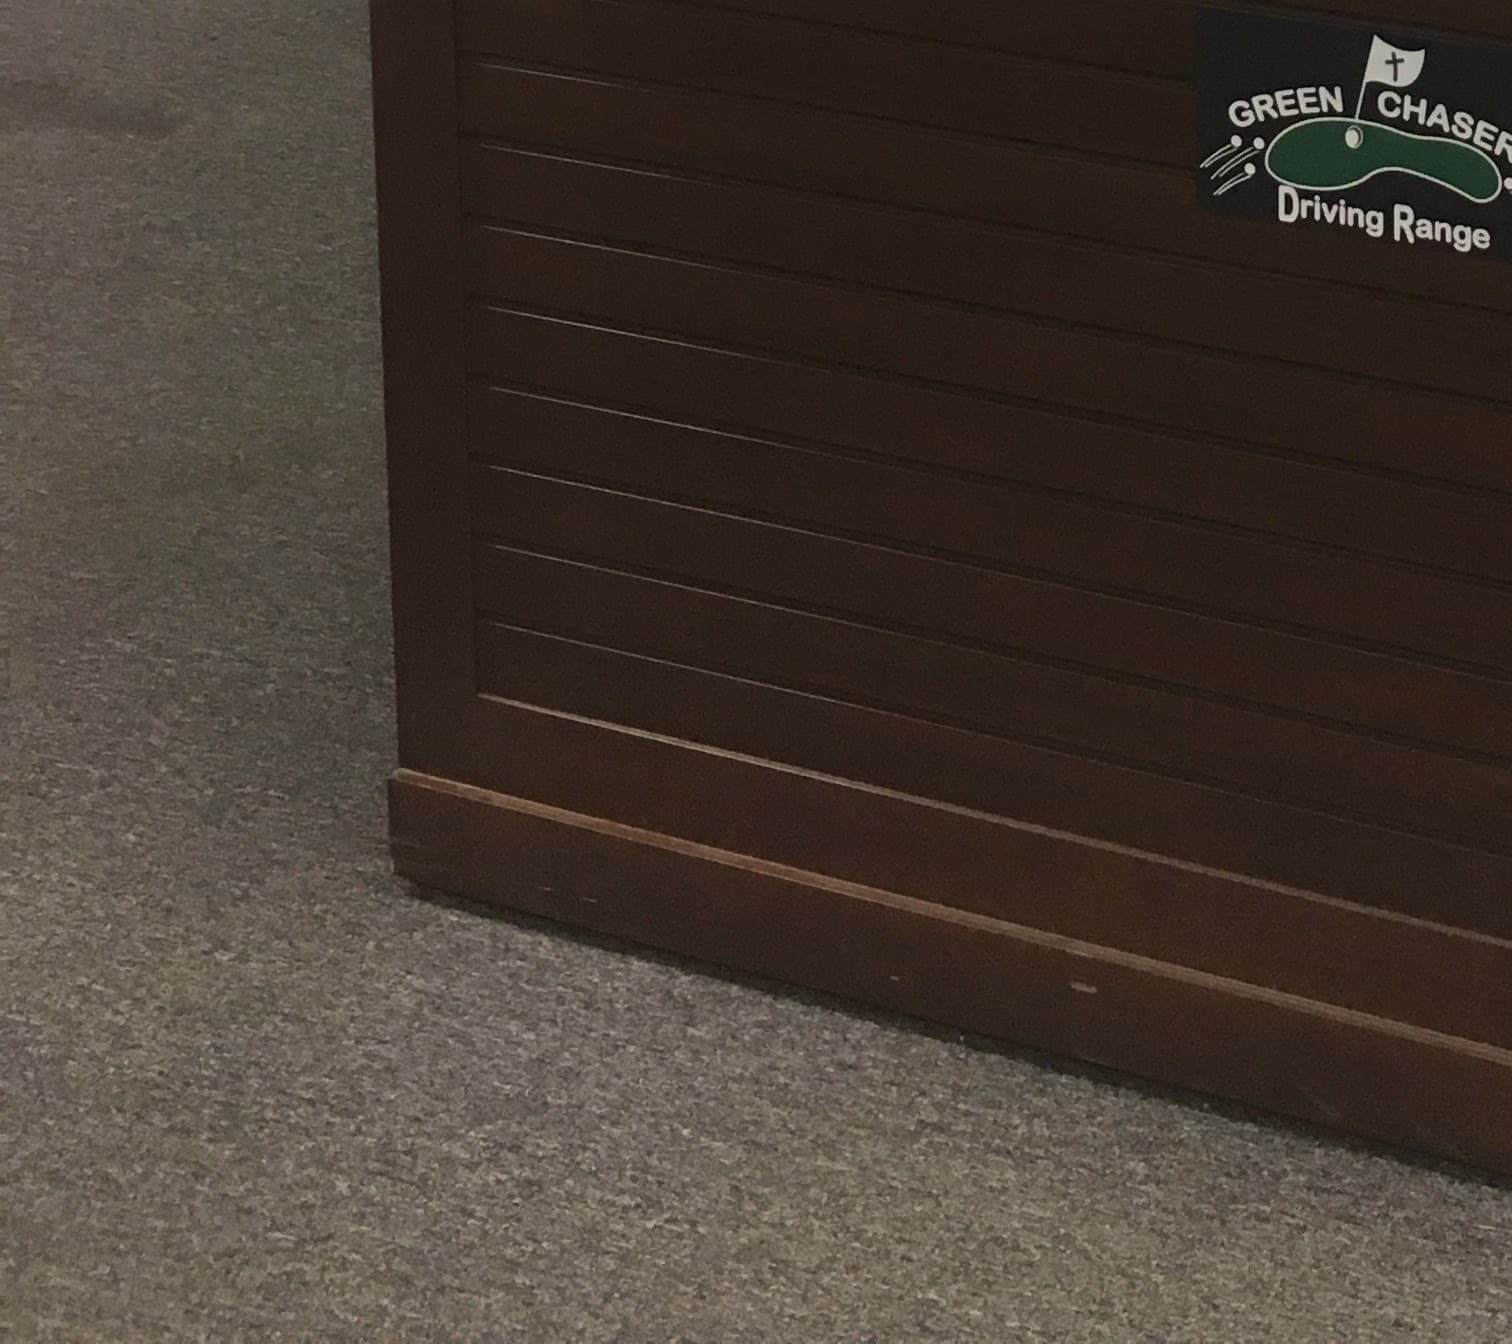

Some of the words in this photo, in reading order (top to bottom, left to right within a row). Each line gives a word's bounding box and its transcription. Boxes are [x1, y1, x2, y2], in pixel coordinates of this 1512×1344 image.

[1228, 86, 1343, 127] GREEN
[1278, 185, 1384, 238] Driving
[1393, 204, 1491, 252] Range
